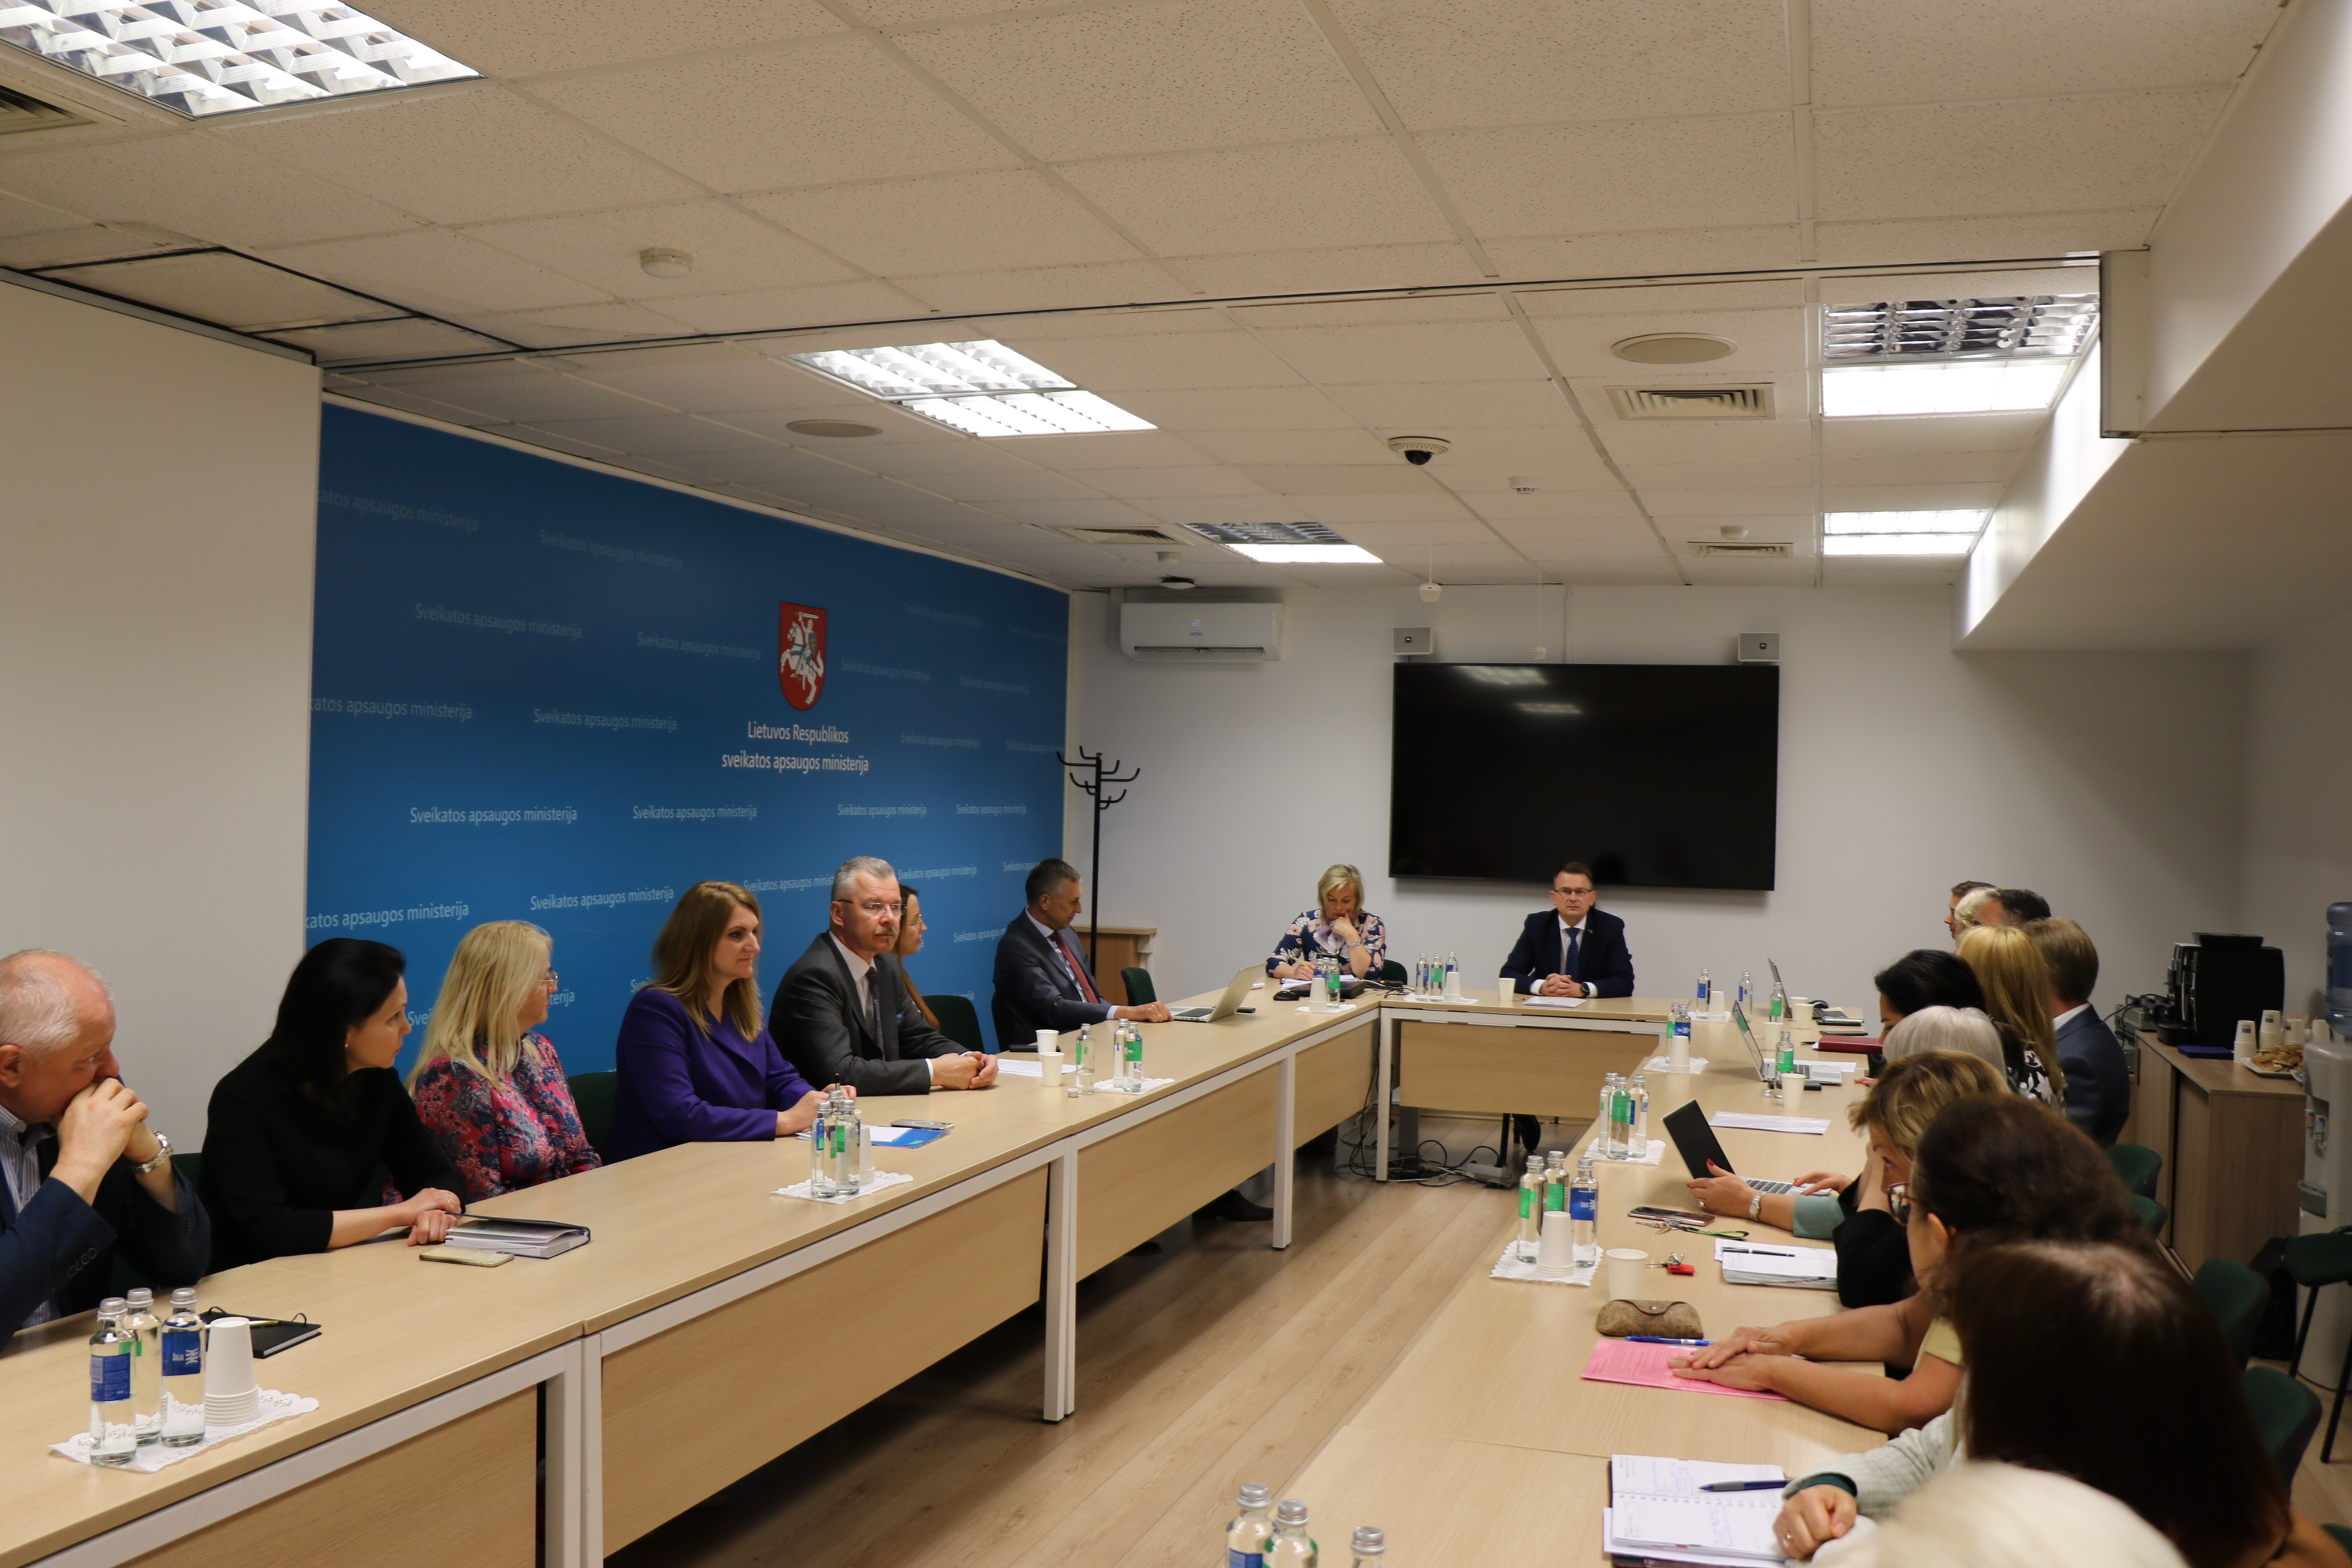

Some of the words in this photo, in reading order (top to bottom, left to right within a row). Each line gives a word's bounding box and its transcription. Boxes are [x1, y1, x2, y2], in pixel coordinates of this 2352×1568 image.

[352, 496, 414, 522] apsaugos
[416, 506, 479, 535] ministerija
[539, 530, 587, 552] Sveikatos
[590, 541, 634, 562] apsaugos
[635, 547, 683, 571] ministerija
[415, 603, 471, 625] Sveikatos
[473, 612, 526, 635] apsaugos
[528, 616, 582, 641] ministerija
[637, 631, 679, 650] Sveikatos
[680, 639, 719, 658] apsaugos
[721, 643, 761, 662] ministerija
[346, 700, 407, 719] apsaugos
[411, 702, 472, 722] ministerija
[533, 707, 582, 726] Sveikatos
[583, 712, 629, 731] apsaugos
[631, 714, 677, 733] ministerija
[748, 721, 790, 741] Lietuvos
[792, 724, 849, 746] Respublikos
[722, 750, 771, 770] sveikatos
[773, 754, 820, 775] apsaugos
[822, 754, 869, 775] ministerija
[410, 806, 466, 823] Sveikatos
[468, 808, 522, 825] apsaugos
[523, 805, 578, 824] ministerija
[633, 805, 674, 819] Sveikatos
[676, 807, 715, 821] apsaugos
[717, 805, 757, 820] ministerija
[838, 803, 867, 816] Sveikatos
[868, 805, 897, 818] apsaugos
[898, 804, 927, 817] ministerija
[956, 804, 979, 815] Sveikatos
[980, 805, 1002, 816] apsaugos
[1003, 804, 1027, 816] ministerija
[743, 878, 778, 891] Sveikatos
[779, 877, 812, 893] apsaugos
[813, 873, 835, 887] minist
[530, 893, 579, 910] Sveikatos
[580, 890, 626, 909] apsaugos
[628, 886, 674, 904] ministerija
[342, 908, 404, 930] apsaugos
[407, 901, 469, 921] ministerija
[548, 989, 575, 1007] terija
